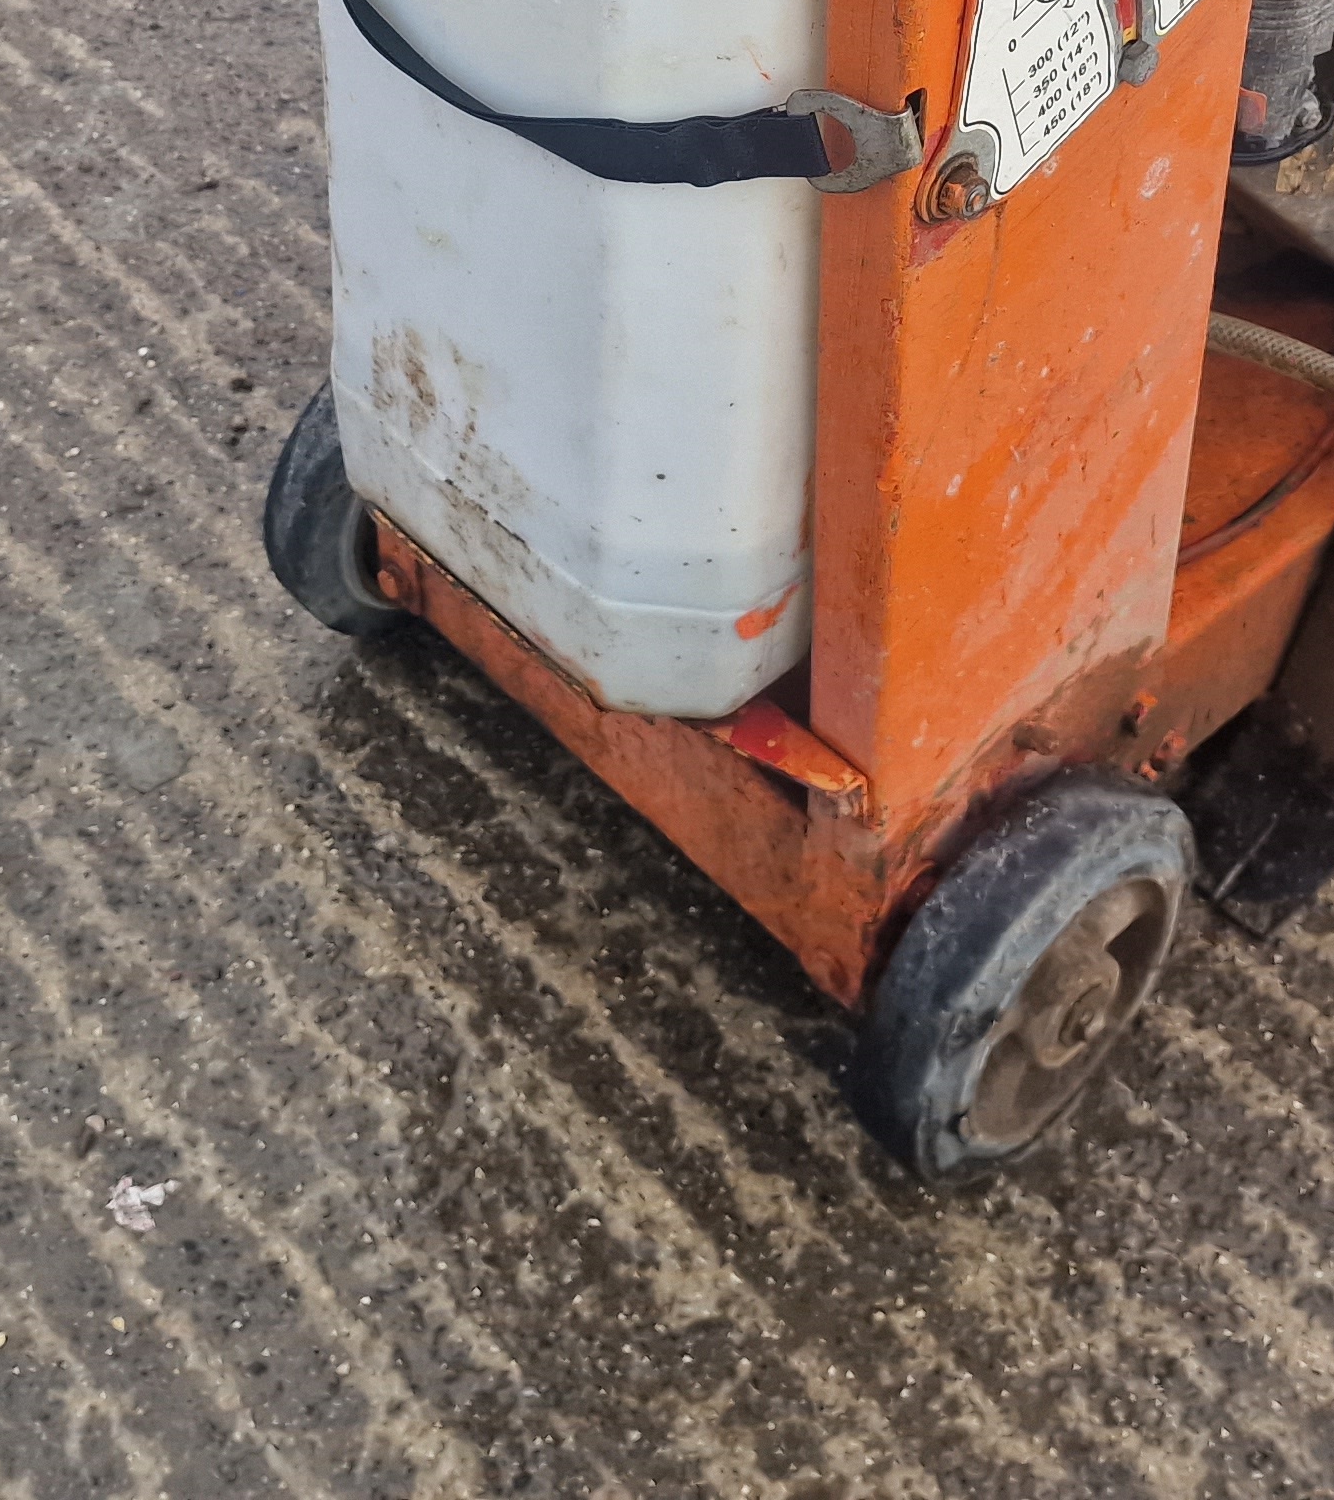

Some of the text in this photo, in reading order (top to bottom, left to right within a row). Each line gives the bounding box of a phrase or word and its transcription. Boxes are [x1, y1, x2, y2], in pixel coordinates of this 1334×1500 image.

[1008, 38, 1017, 52] 0
[1028, 10, 1090, 78] 300 (12")
[1033, 31, 1094, 98] 350 (14")
[1038, 51, 1098, 117] 400 (16")
[1043, 71, 1102, 137] 450 (18")
